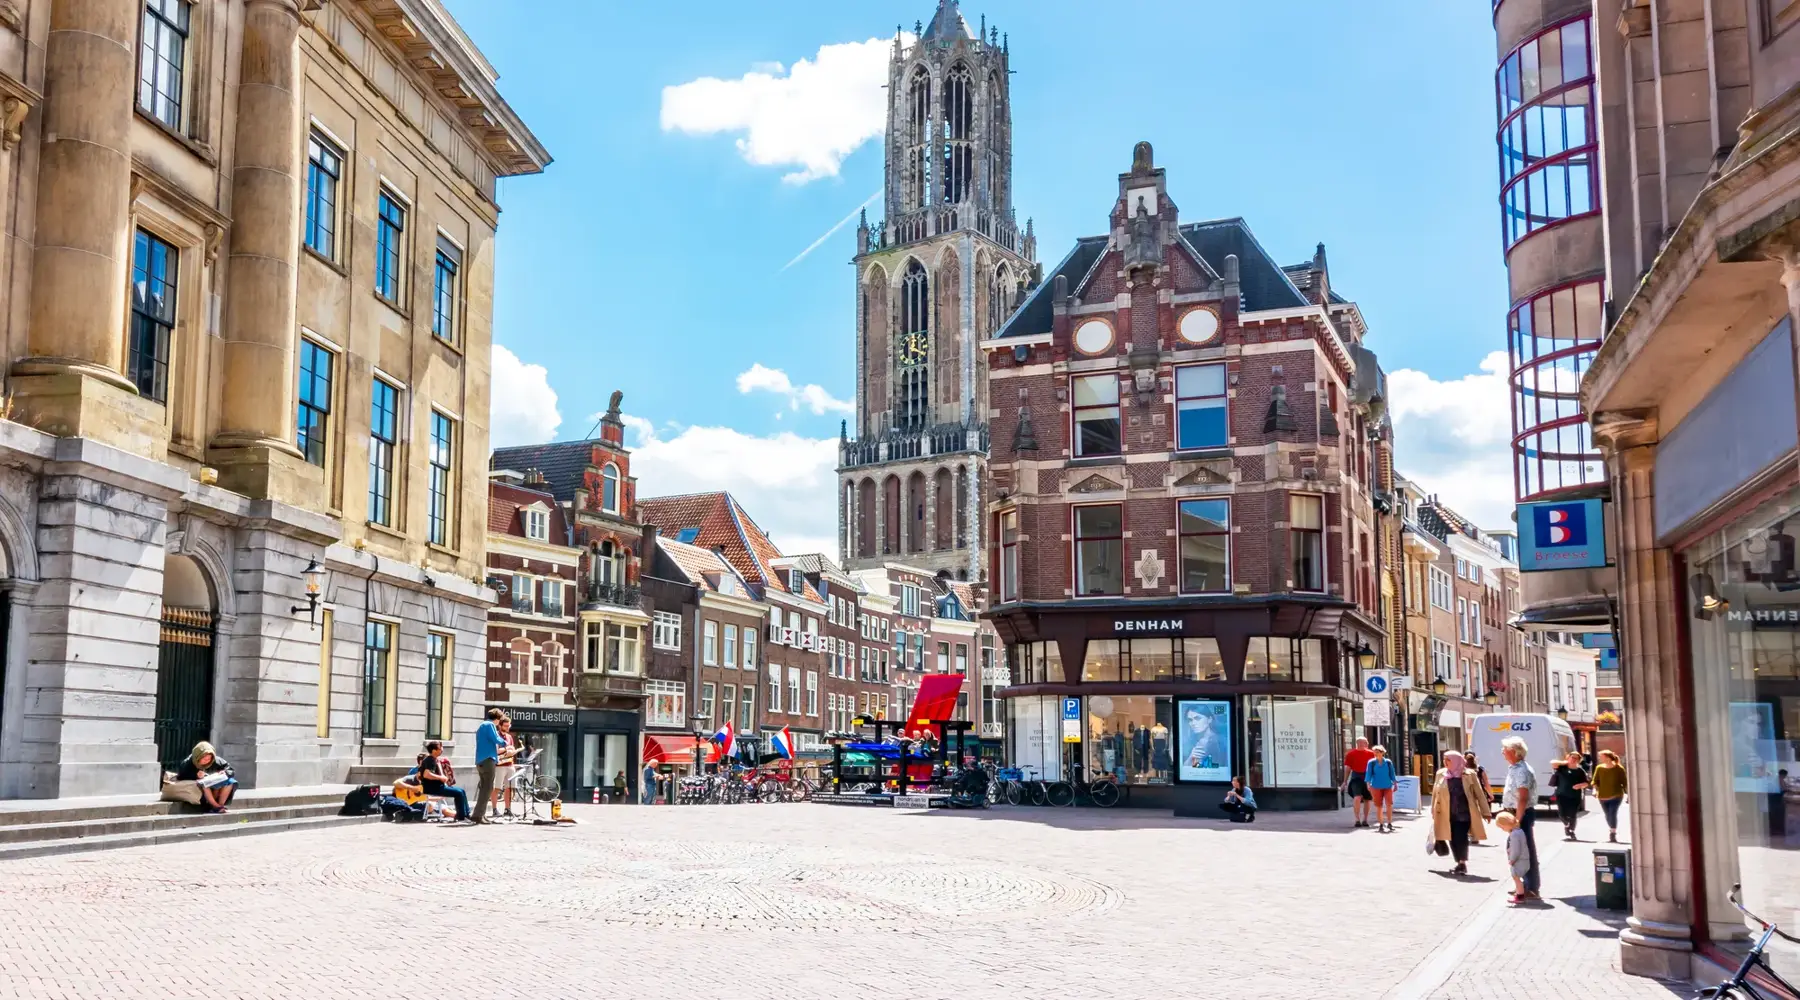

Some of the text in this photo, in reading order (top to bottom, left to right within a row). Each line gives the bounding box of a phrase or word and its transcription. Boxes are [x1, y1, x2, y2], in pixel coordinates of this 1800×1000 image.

[1535, 550, 1588, 560] Broese
[1114, 620, 1183, 631] DENHAM
[1067, 700, 1076, 711] P
[540, 710, 574, 725] Liesting
[1511, 722, 1532, 731] GLS
